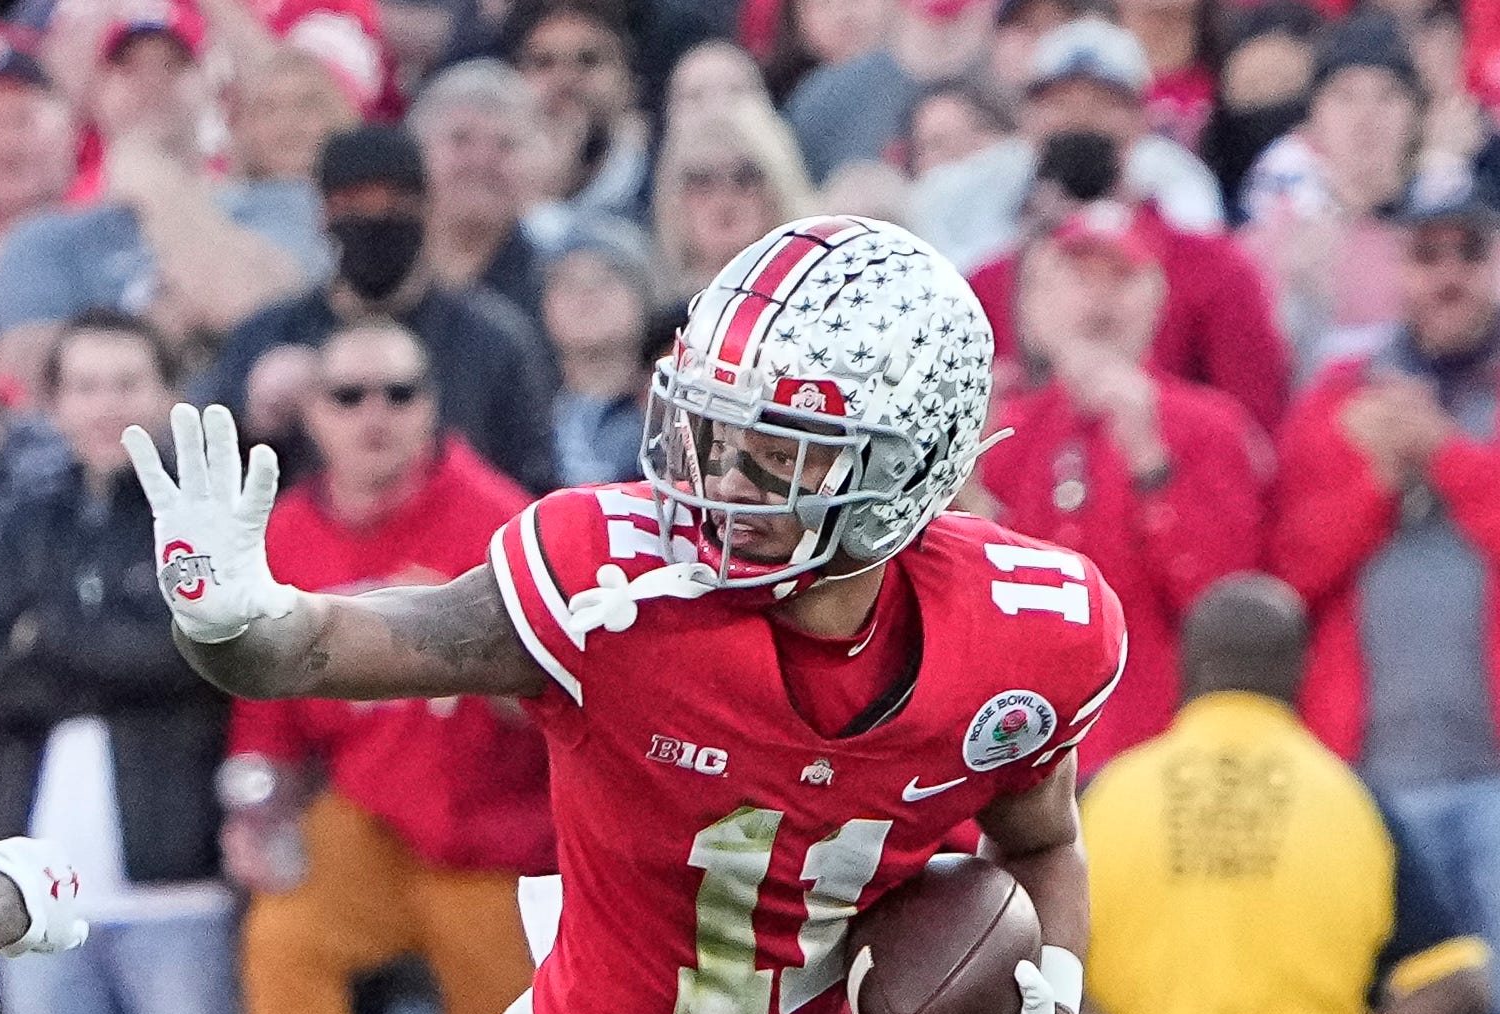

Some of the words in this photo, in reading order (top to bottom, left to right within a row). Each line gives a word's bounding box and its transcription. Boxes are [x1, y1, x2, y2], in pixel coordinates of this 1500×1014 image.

[983, 542, 1091, 625] 11
[969, 705, 996, 742] ROSE
[997, 695, 1034, 710] BOWL
